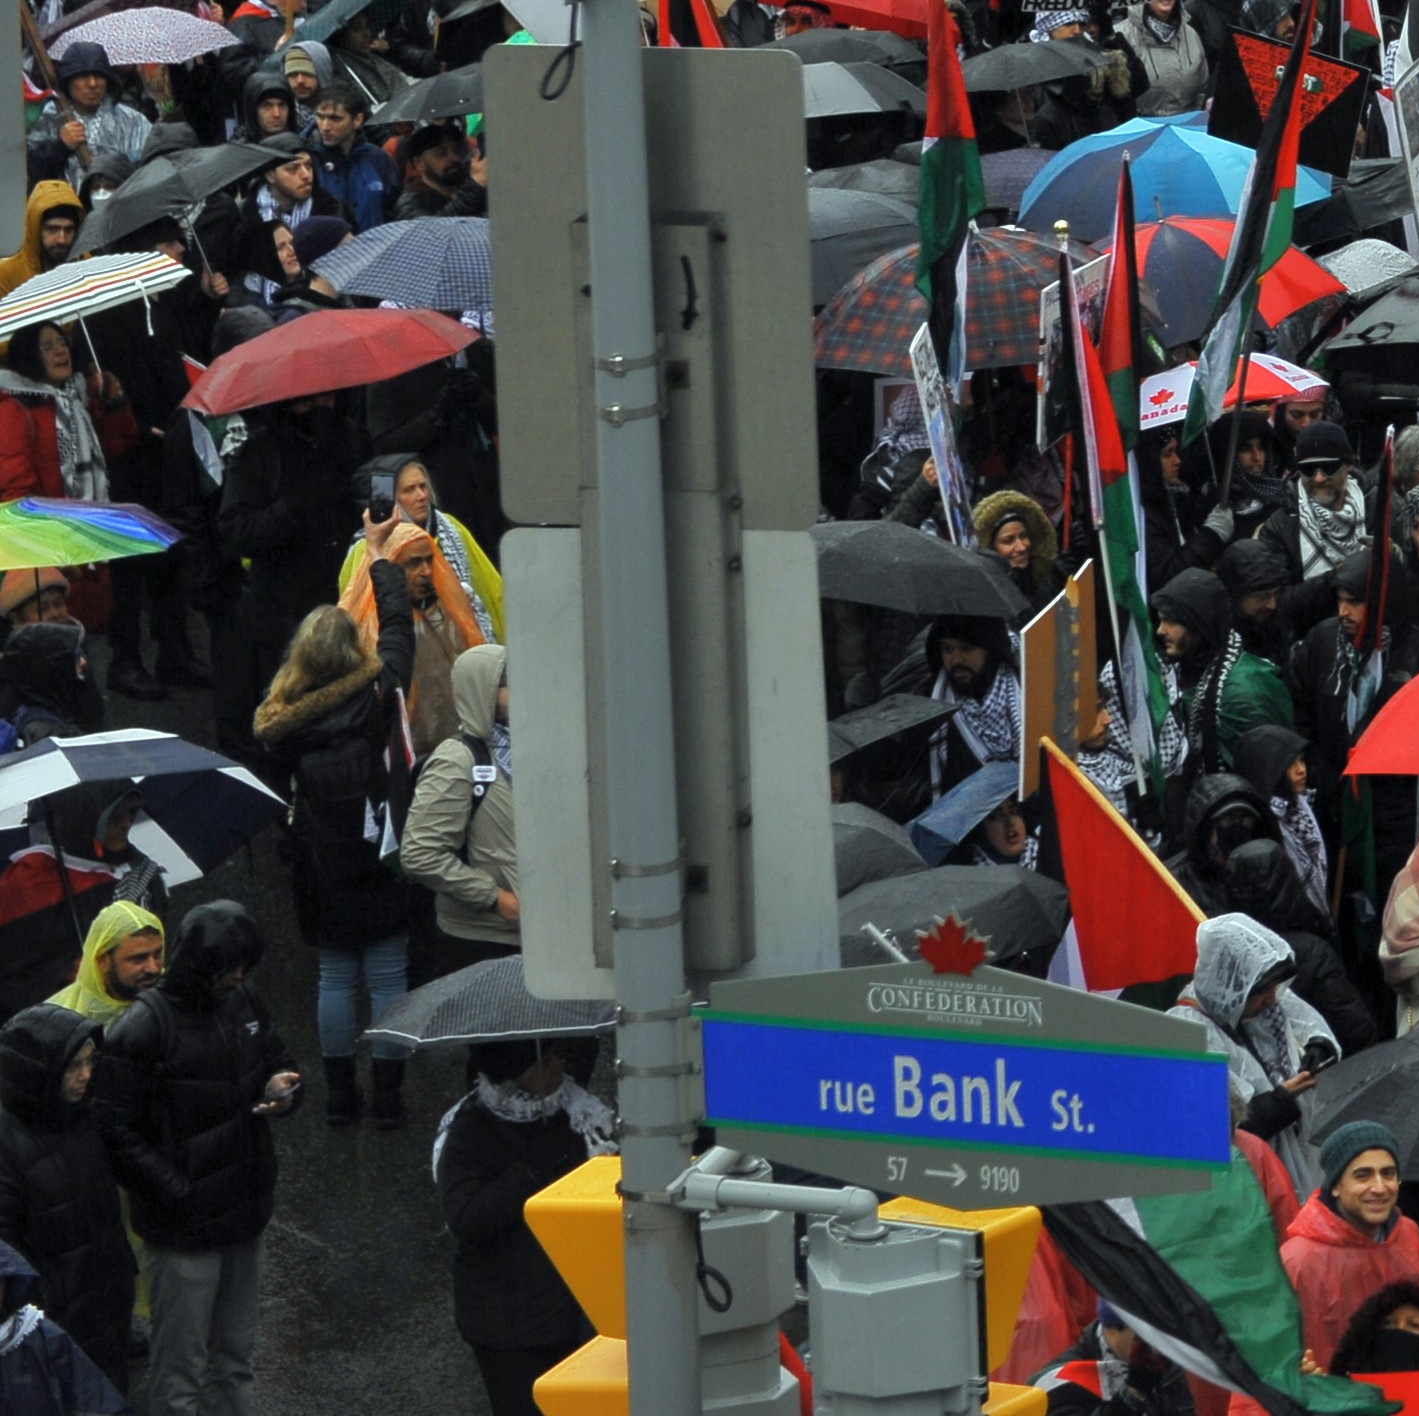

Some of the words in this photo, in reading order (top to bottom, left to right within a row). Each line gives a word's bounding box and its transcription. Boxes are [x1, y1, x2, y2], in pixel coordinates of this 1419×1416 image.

[1141, 402, 1191, 422] anada
[867, 982, 1043, 1027] CONFÉDÉRATION
[819, 1077, 876, 1116] rue
[892, 1054, 1024, 1129] Bank
[1050, 1088, 1097, 1135] St.
[886, 1155, 908, 1183] 57
[979, 1163, 1021, 1194] 9190
